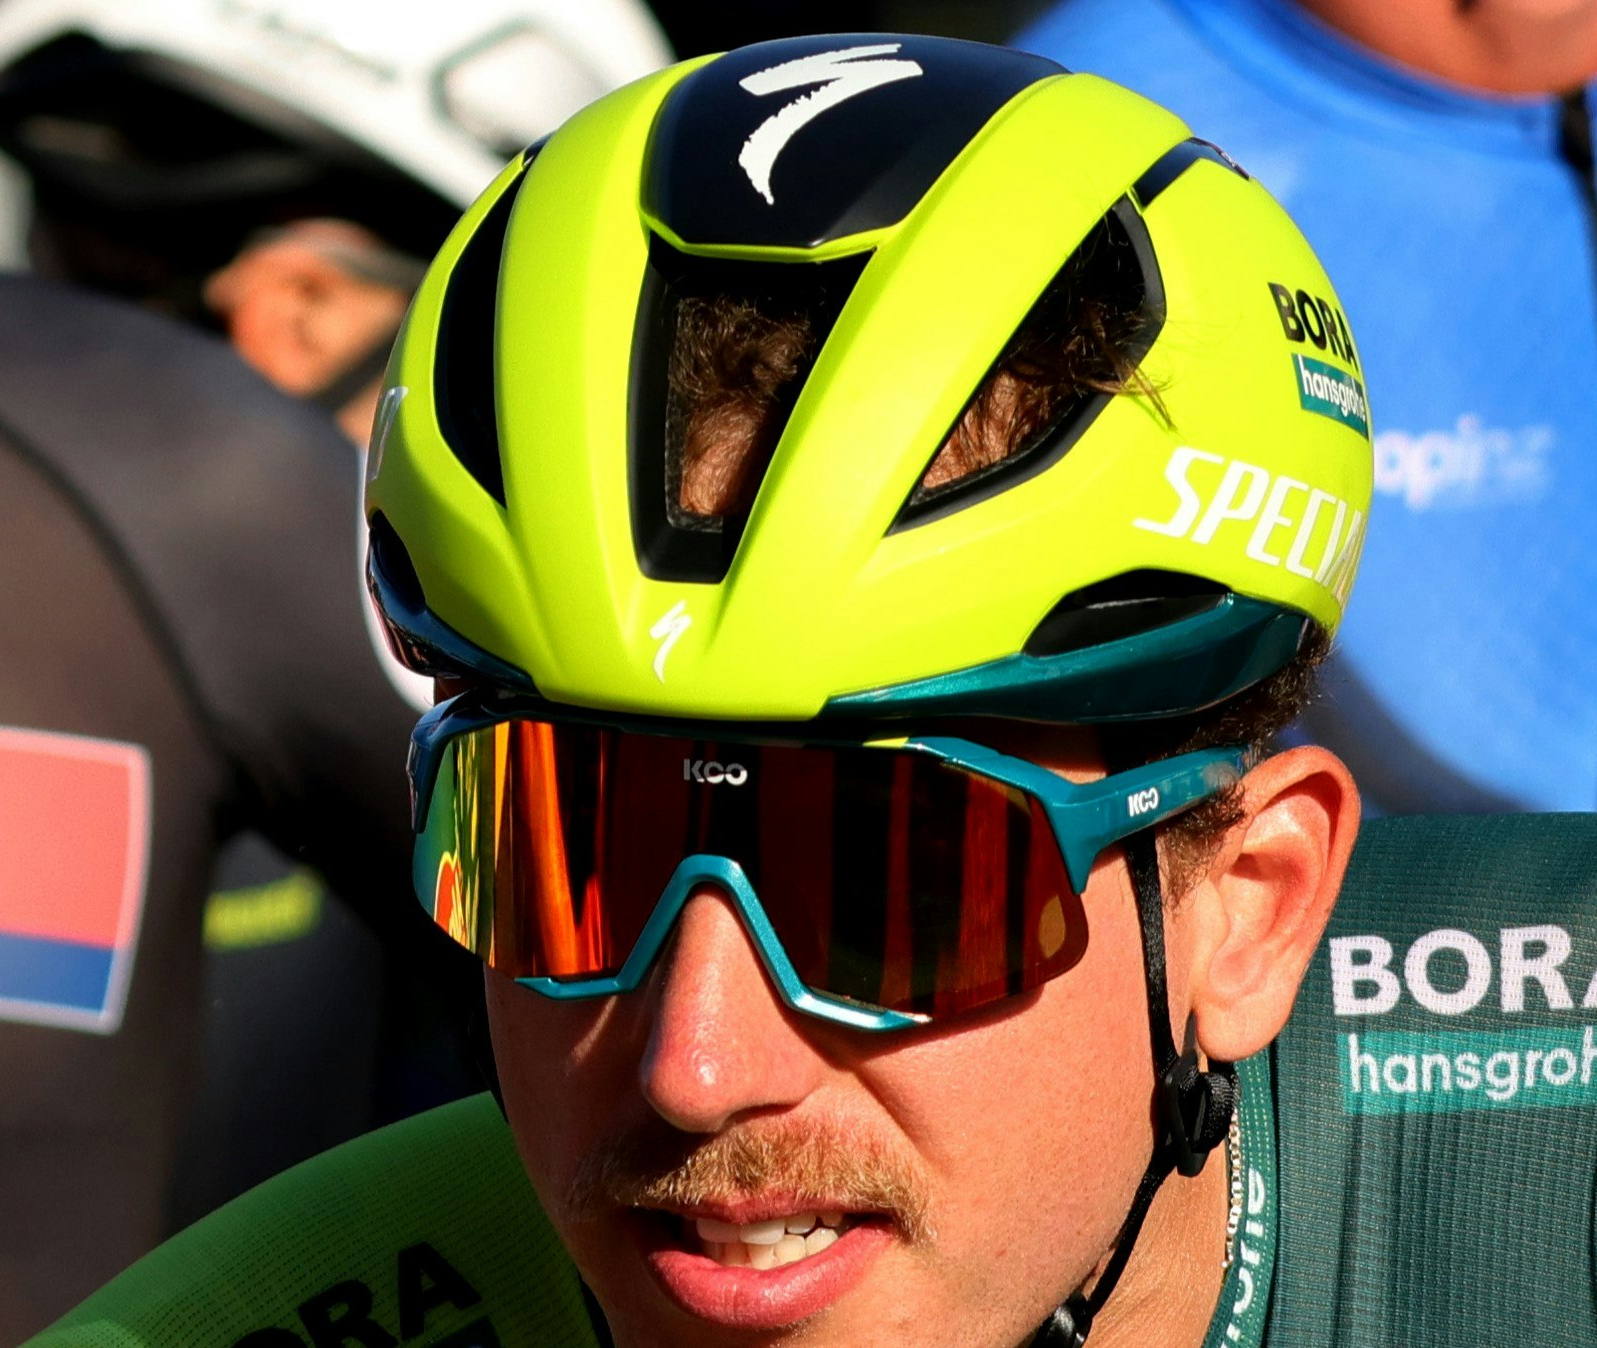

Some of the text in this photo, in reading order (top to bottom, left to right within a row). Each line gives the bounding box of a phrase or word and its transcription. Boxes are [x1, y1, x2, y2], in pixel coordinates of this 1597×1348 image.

[1268, 281, 1360, 373] BORA
[683, 758, 748, 786] KOO
[1128, 787, 1159, 818] KOO
